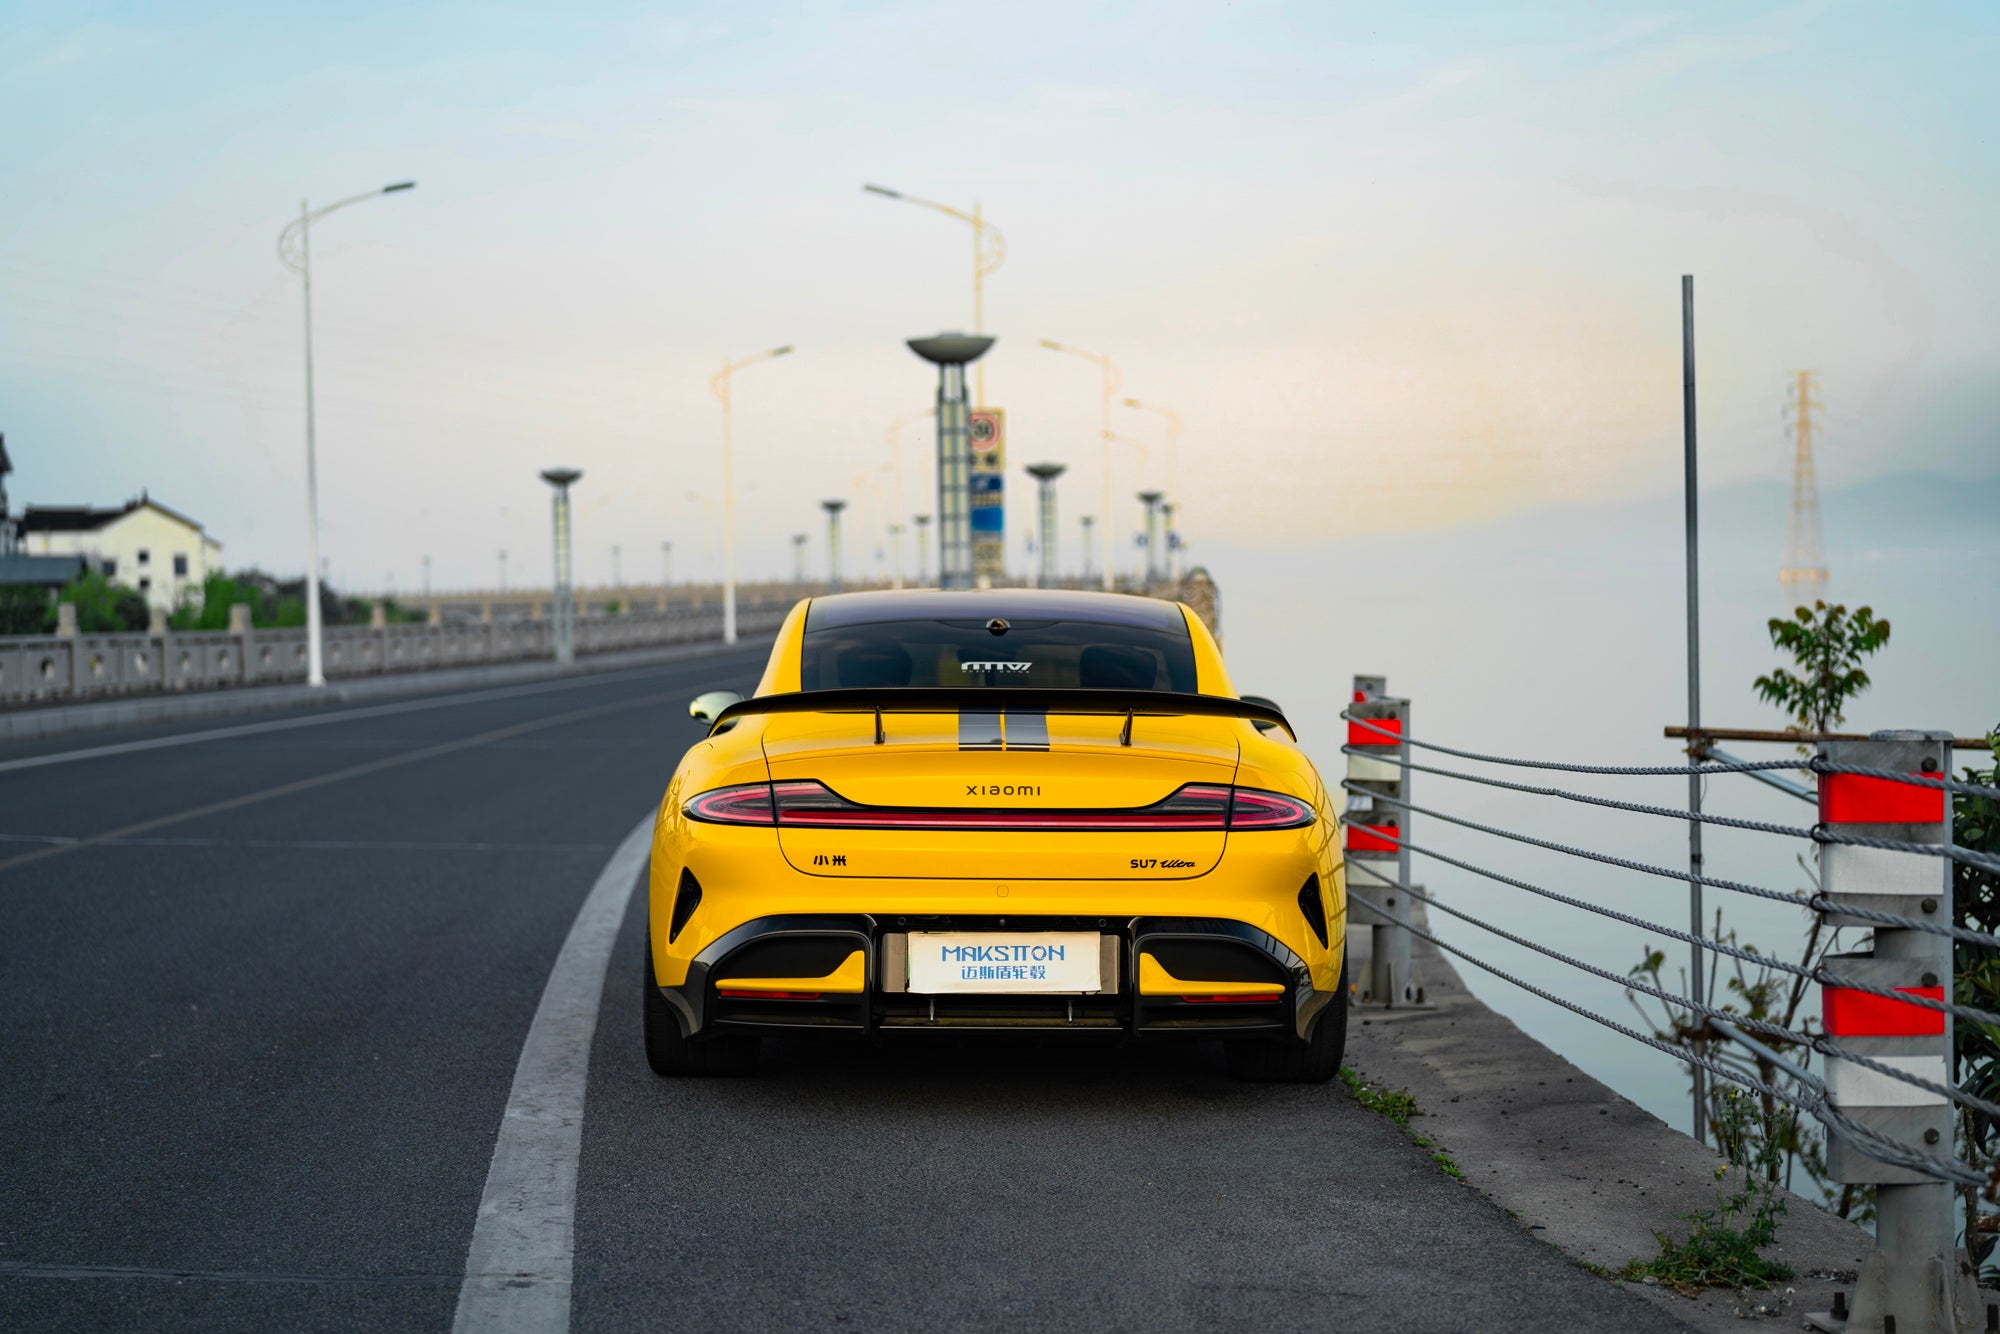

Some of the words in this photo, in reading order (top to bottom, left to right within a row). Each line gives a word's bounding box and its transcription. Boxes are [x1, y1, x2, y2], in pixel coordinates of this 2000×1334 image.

[813, 854, 847, 866] 小米
[1130, 859, 1158, 869] SU7
[1160, 859, 1196, 868] Ultra
[961, 965, 1046, 980] 迈斯盾轮毂
